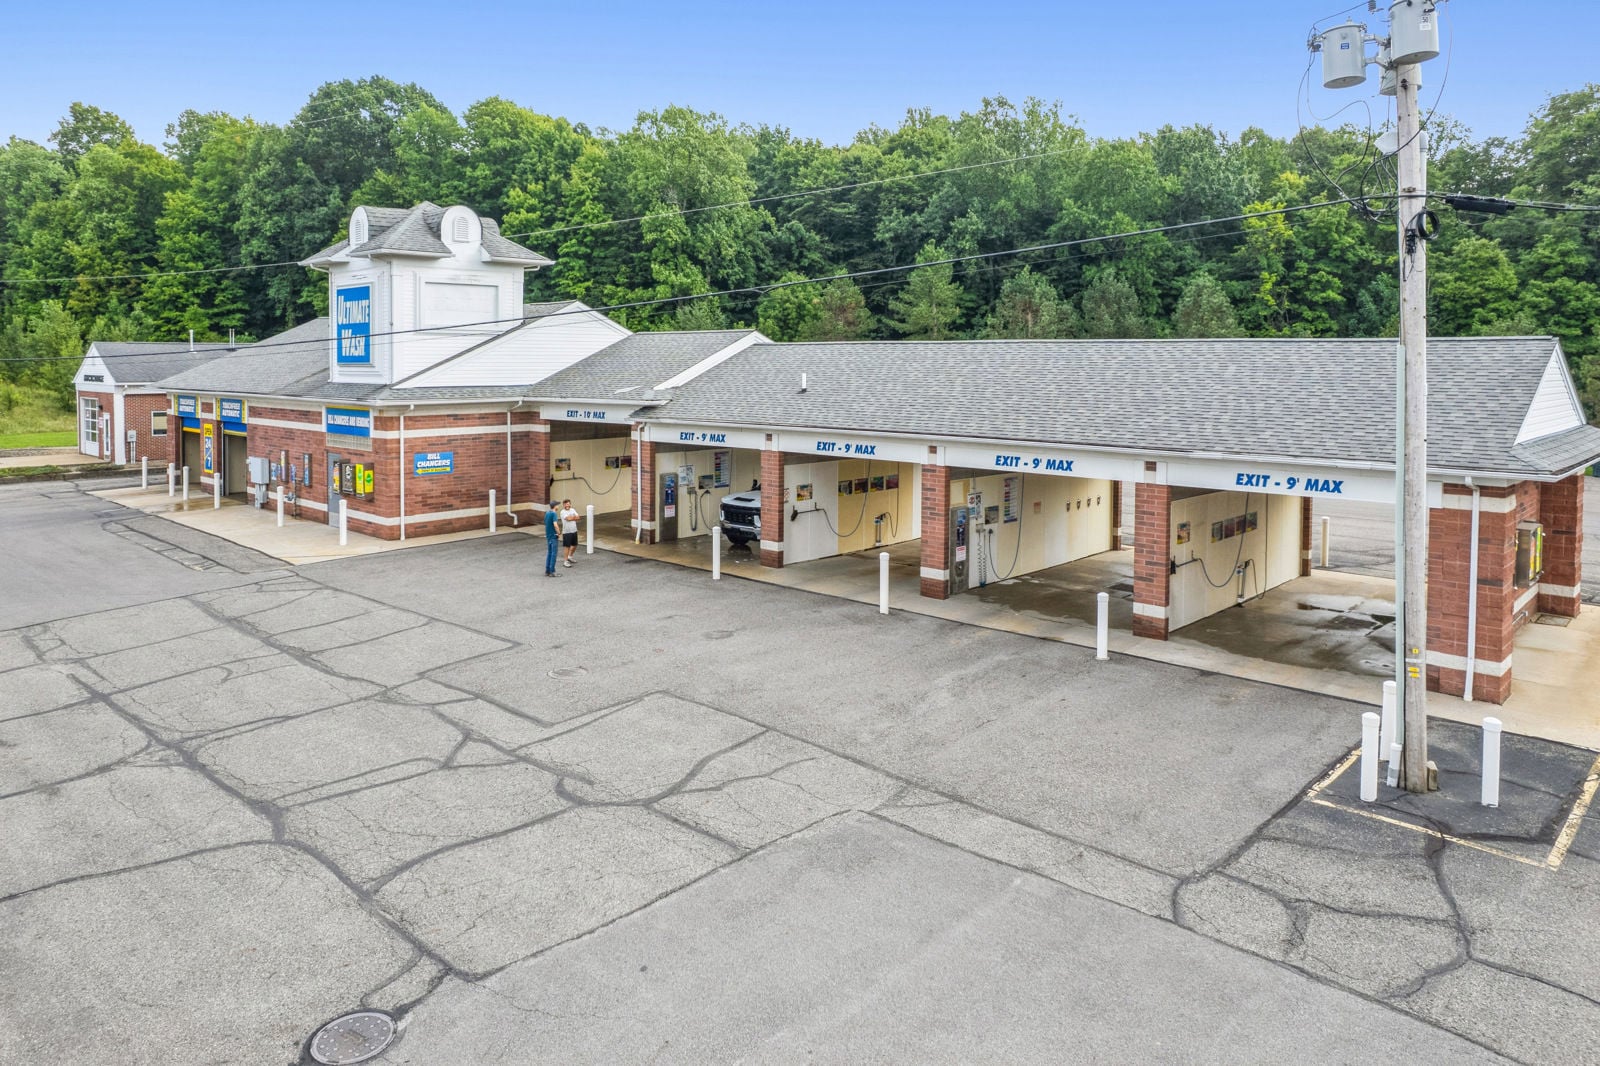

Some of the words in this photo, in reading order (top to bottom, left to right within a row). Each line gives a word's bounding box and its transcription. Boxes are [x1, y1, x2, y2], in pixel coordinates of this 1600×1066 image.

[338, 296, 369, 325] ULTIMATE
[342, 329, 365, 356] WASH
[566, 410, 579, 418] EXIT
[593, 411, 606, 419] MAX
[680, 432, 695, 441] EXIT
[709, 433, 726, 443] MAX
[816, 441, 836, 452] EXIT
[844, 443, 852, 453] 9'
[854, 444, 876, 455] MAX
[417, 459, 450, 468] CHANGERS
[995, 455, 1021, 467] EXIT
[1032, 457, 1042, 469] 9'
[1045, 459, 1074, 471] MAX
[1236, 473, 1270, 487] EXIT
[1286, 477, 1299, 489] 9'
[1304, 478, 1344, 493] MAX
